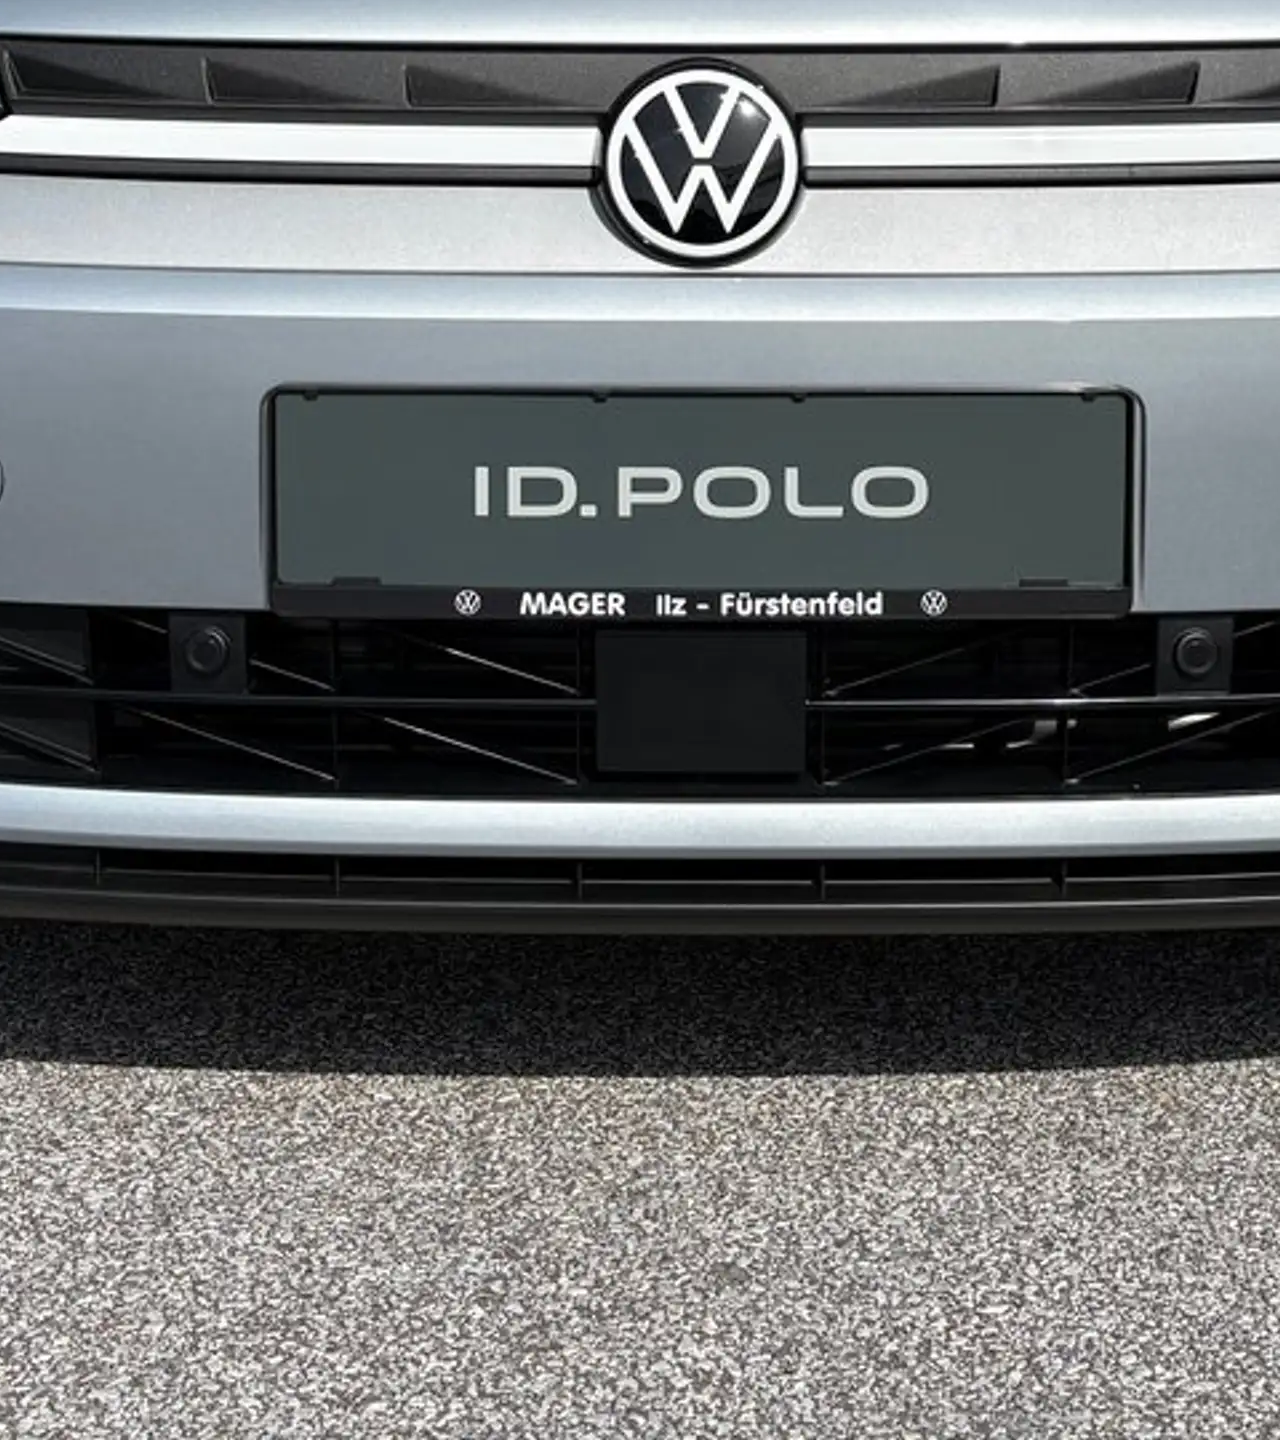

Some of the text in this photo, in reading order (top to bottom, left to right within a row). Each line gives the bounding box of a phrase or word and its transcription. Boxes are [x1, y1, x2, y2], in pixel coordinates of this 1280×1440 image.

[610, 71, 795, 252] VW
[519, 591, 626, 617] MAGER
[655, 593, 687, 617] Ilz
[720, 590, 884, 617] Fürstenfeld
